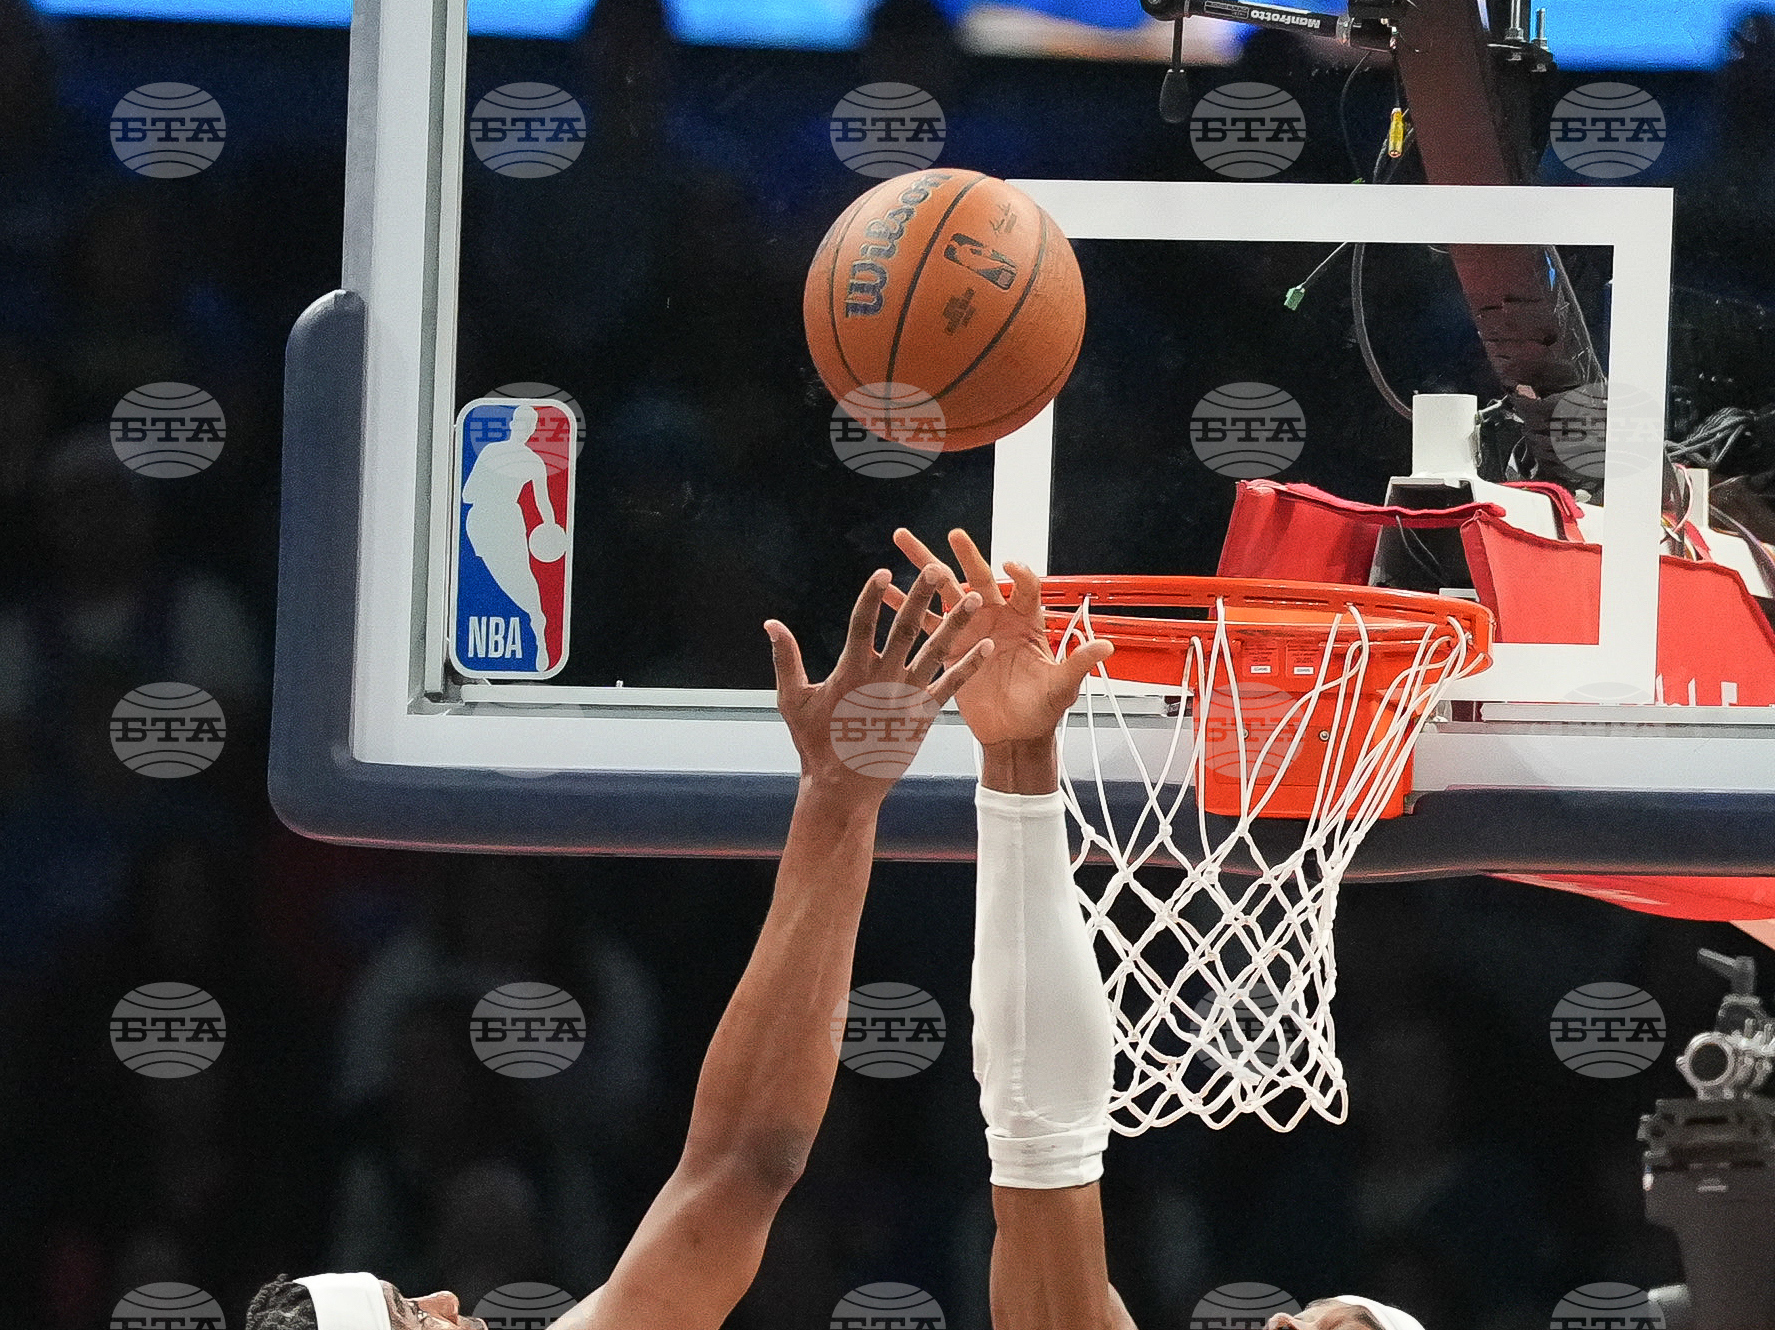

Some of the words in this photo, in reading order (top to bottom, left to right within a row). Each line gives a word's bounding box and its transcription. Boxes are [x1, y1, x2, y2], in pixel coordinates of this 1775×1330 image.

[1250, 9, 1321, 29] Manfrotto
[845, 173, 952, 318] Wilson
[467, 616, 523, 659] NBA
